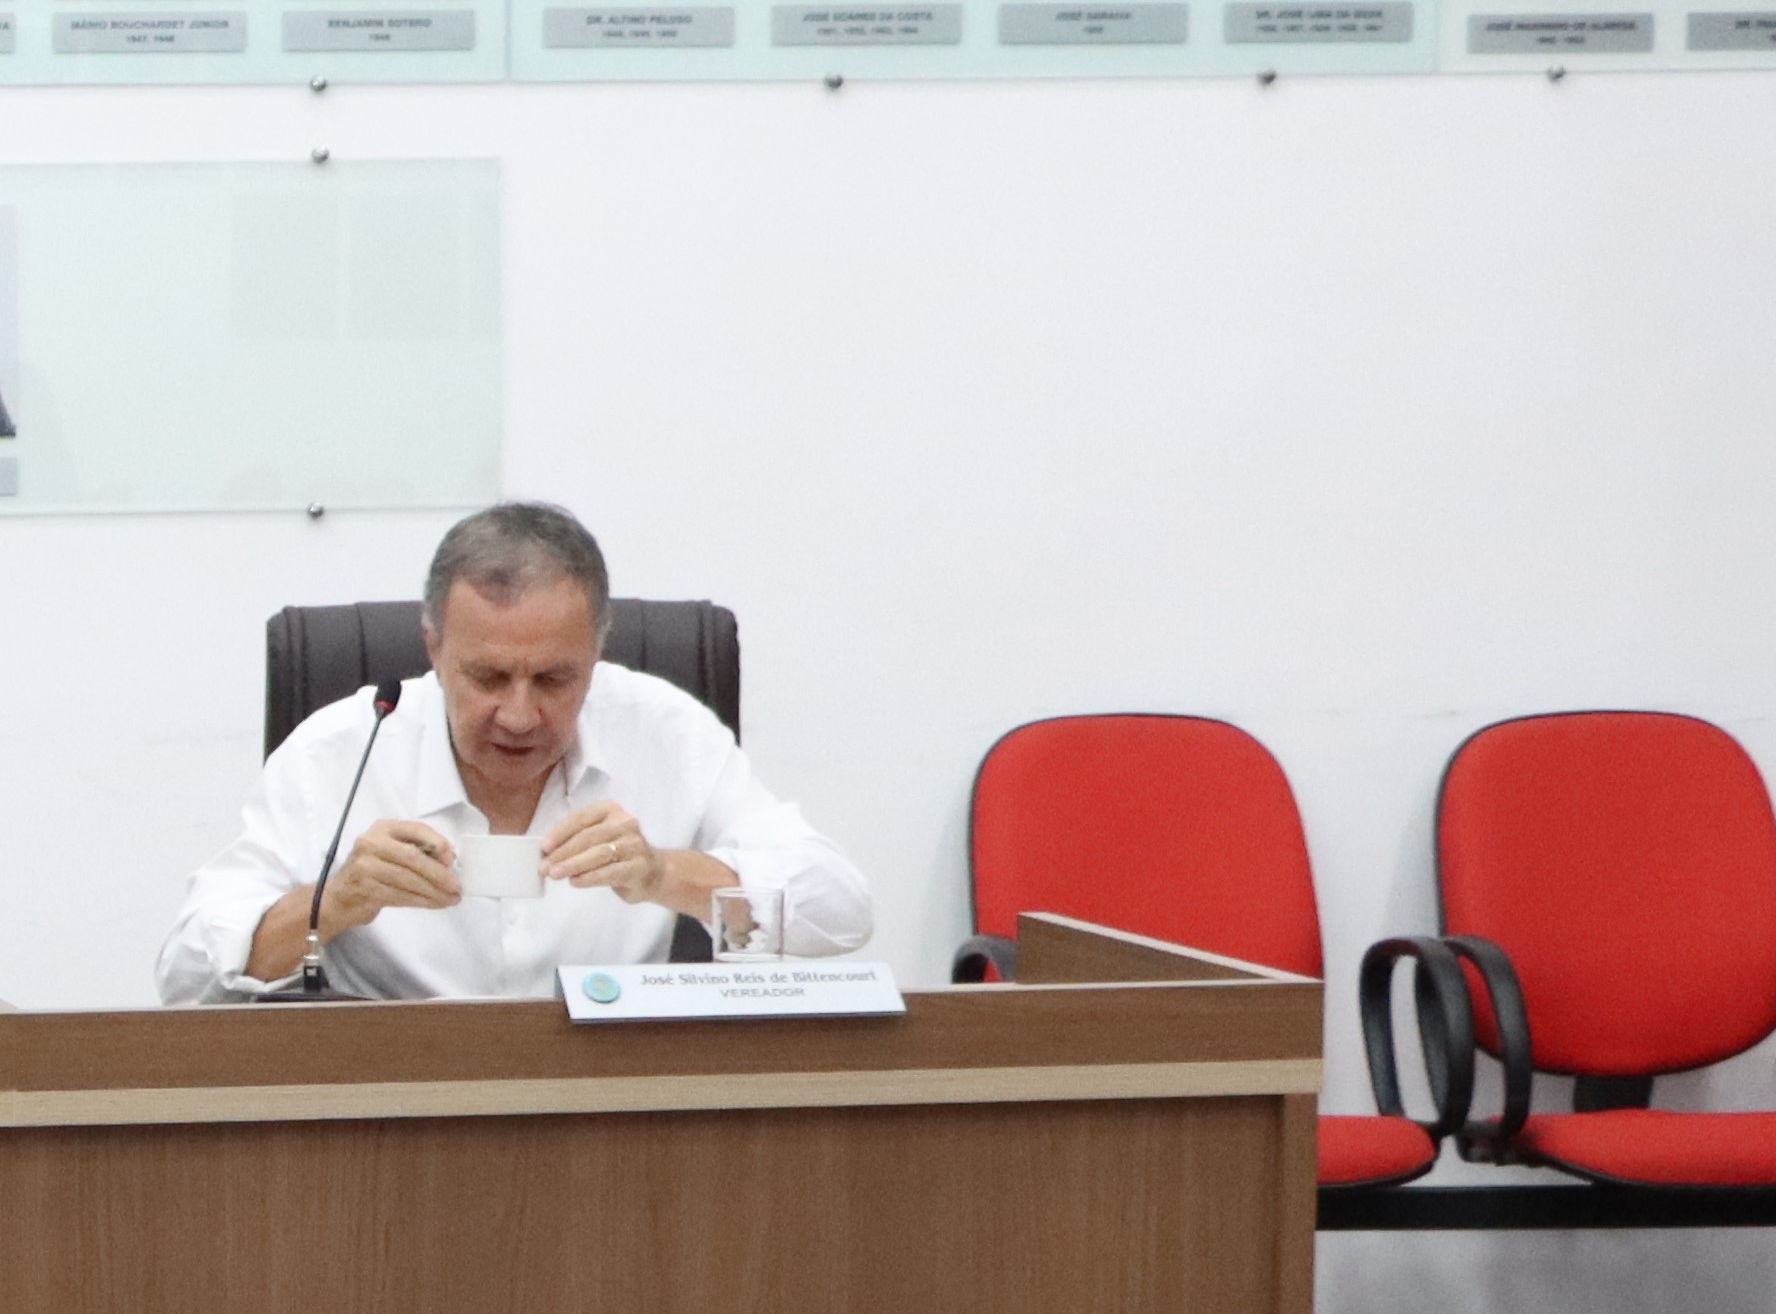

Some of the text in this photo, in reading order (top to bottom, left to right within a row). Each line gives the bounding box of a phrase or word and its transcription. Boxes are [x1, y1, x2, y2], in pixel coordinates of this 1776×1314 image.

[640, 973, 674, 985] José
[678, 973, 729, 985] Silvino
[733, 973, 766, 984] Reis
[770, 973, 788, 984] de
[720, 988, 806, 998] VEREADOR
